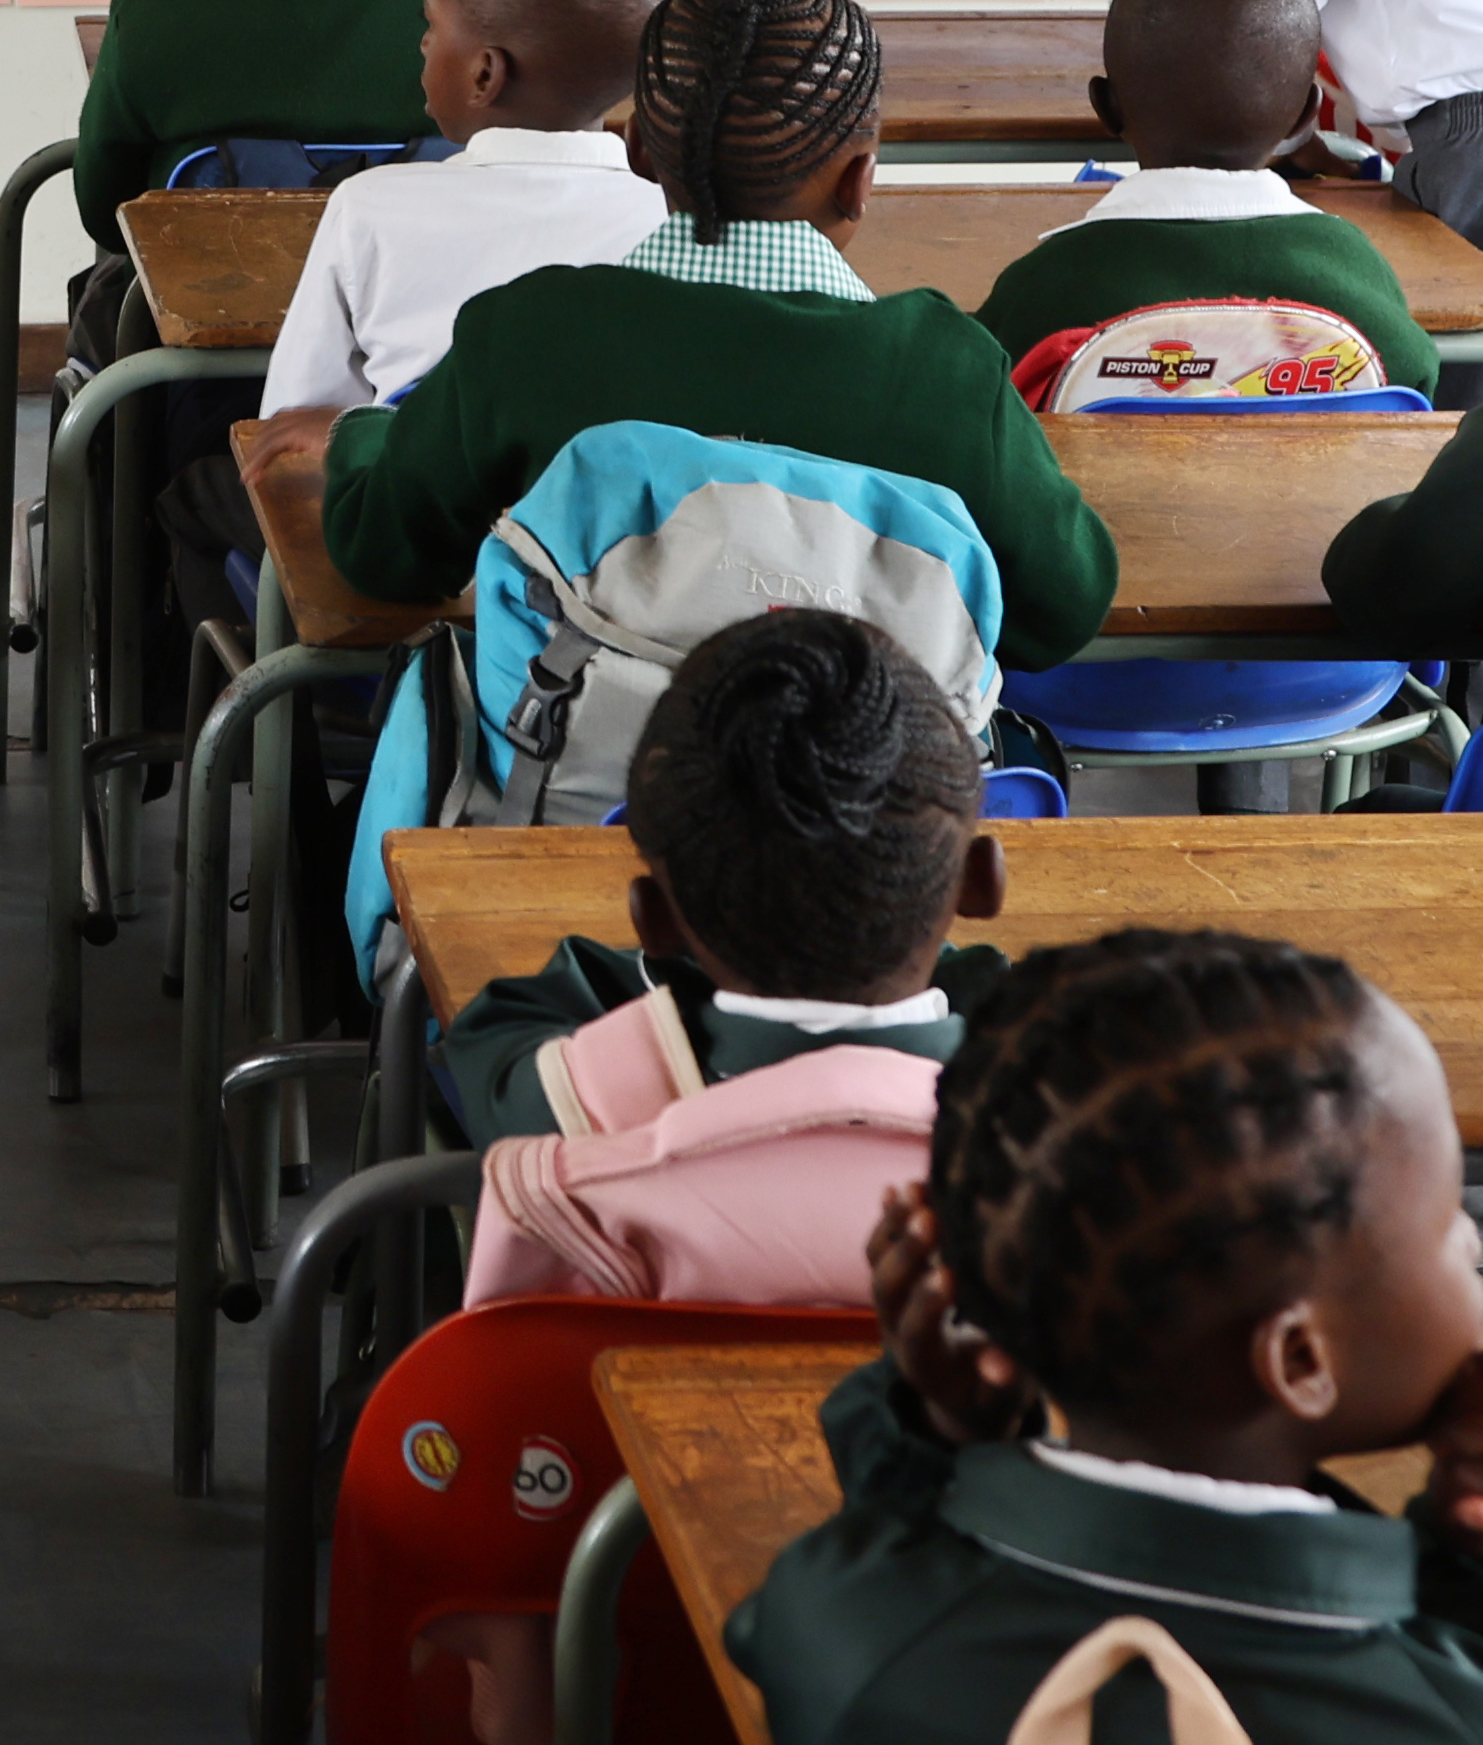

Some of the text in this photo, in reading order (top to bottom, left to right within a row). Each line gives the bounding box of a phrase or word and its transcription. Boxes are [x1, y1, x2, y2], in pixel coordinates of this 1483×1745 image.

[1106, 360, 1211, 375] PISTON CUP
[1265, 355, 1340, 396] 95
